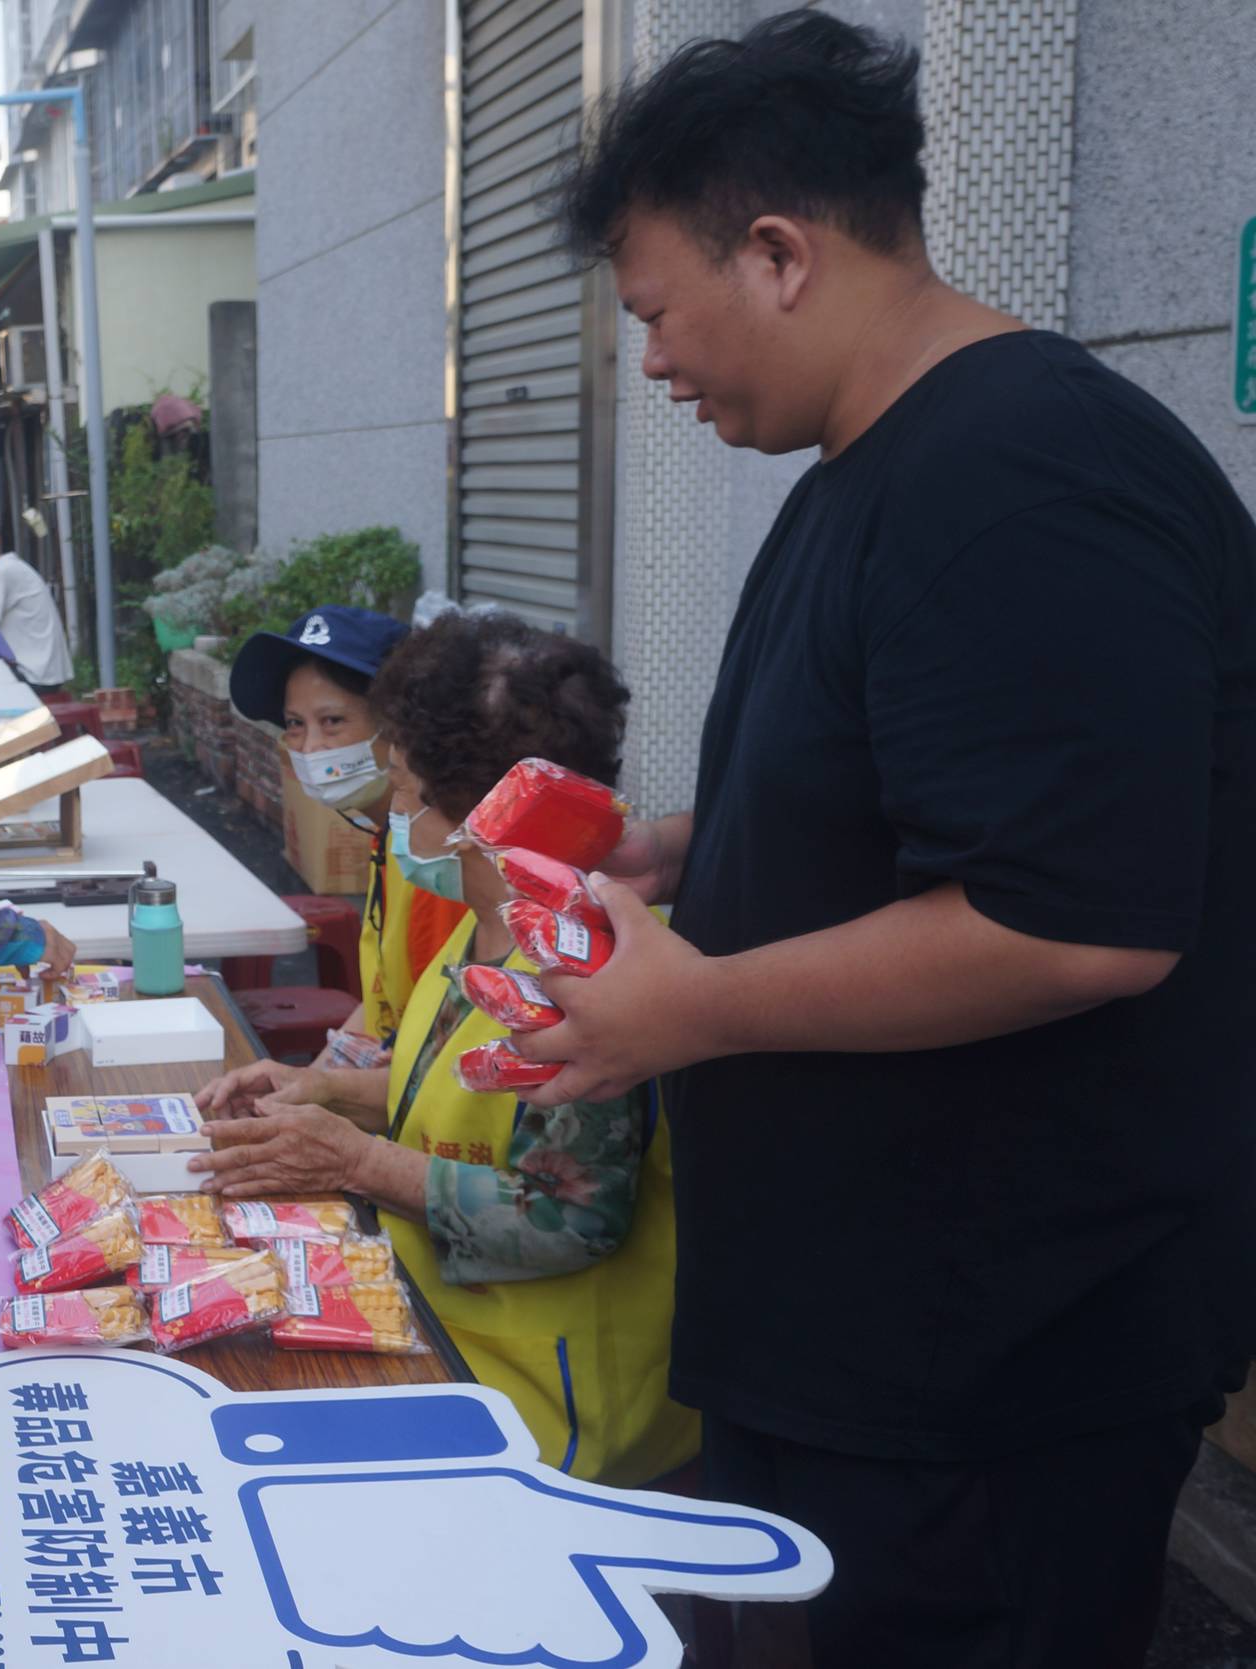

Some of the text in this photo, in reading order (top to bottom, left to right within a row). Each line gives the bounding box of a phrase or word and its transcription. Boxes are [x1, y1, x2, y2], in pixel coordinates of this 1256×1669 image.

[8, 1382, 130, 1664] 毒品危害防制中
[109, 1460, 224, 1597] 嘉義市
